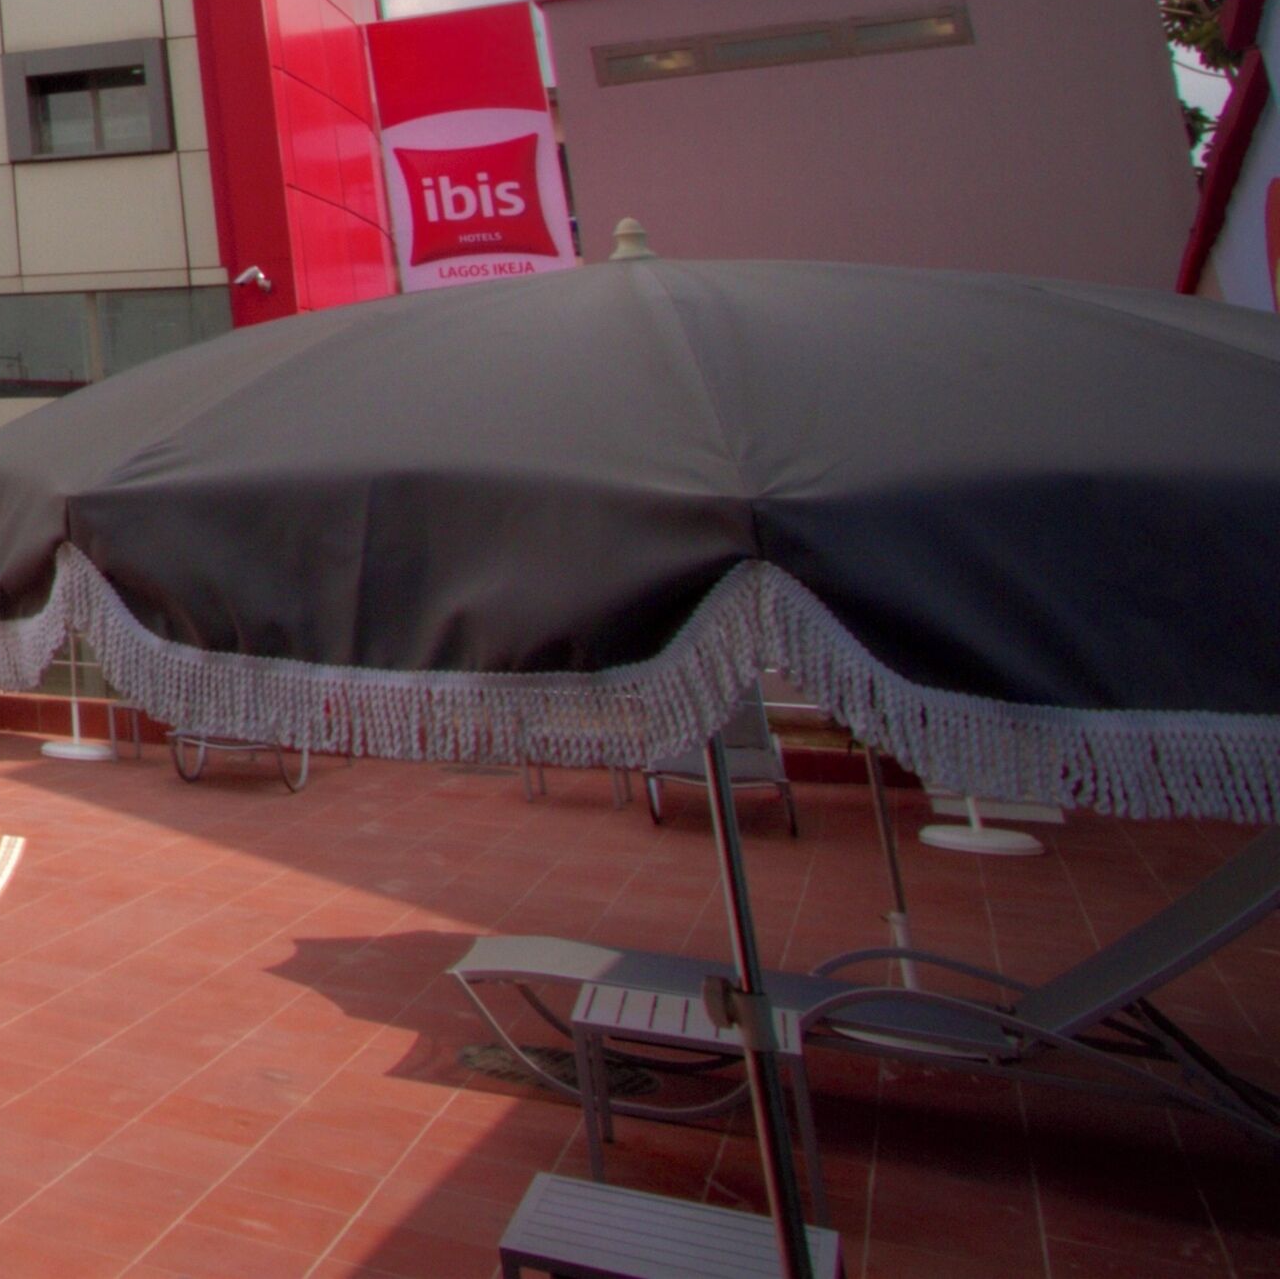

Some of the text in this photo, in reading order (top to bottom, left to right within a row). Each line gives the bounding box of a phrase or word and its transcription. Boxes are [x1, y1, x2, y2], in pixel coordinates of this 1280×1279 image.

[421, 171, 526, 223] ibis
[458, 231, 502, 244] HOTELS
[438, 260, 536, 279] LAGOS IKEJA
